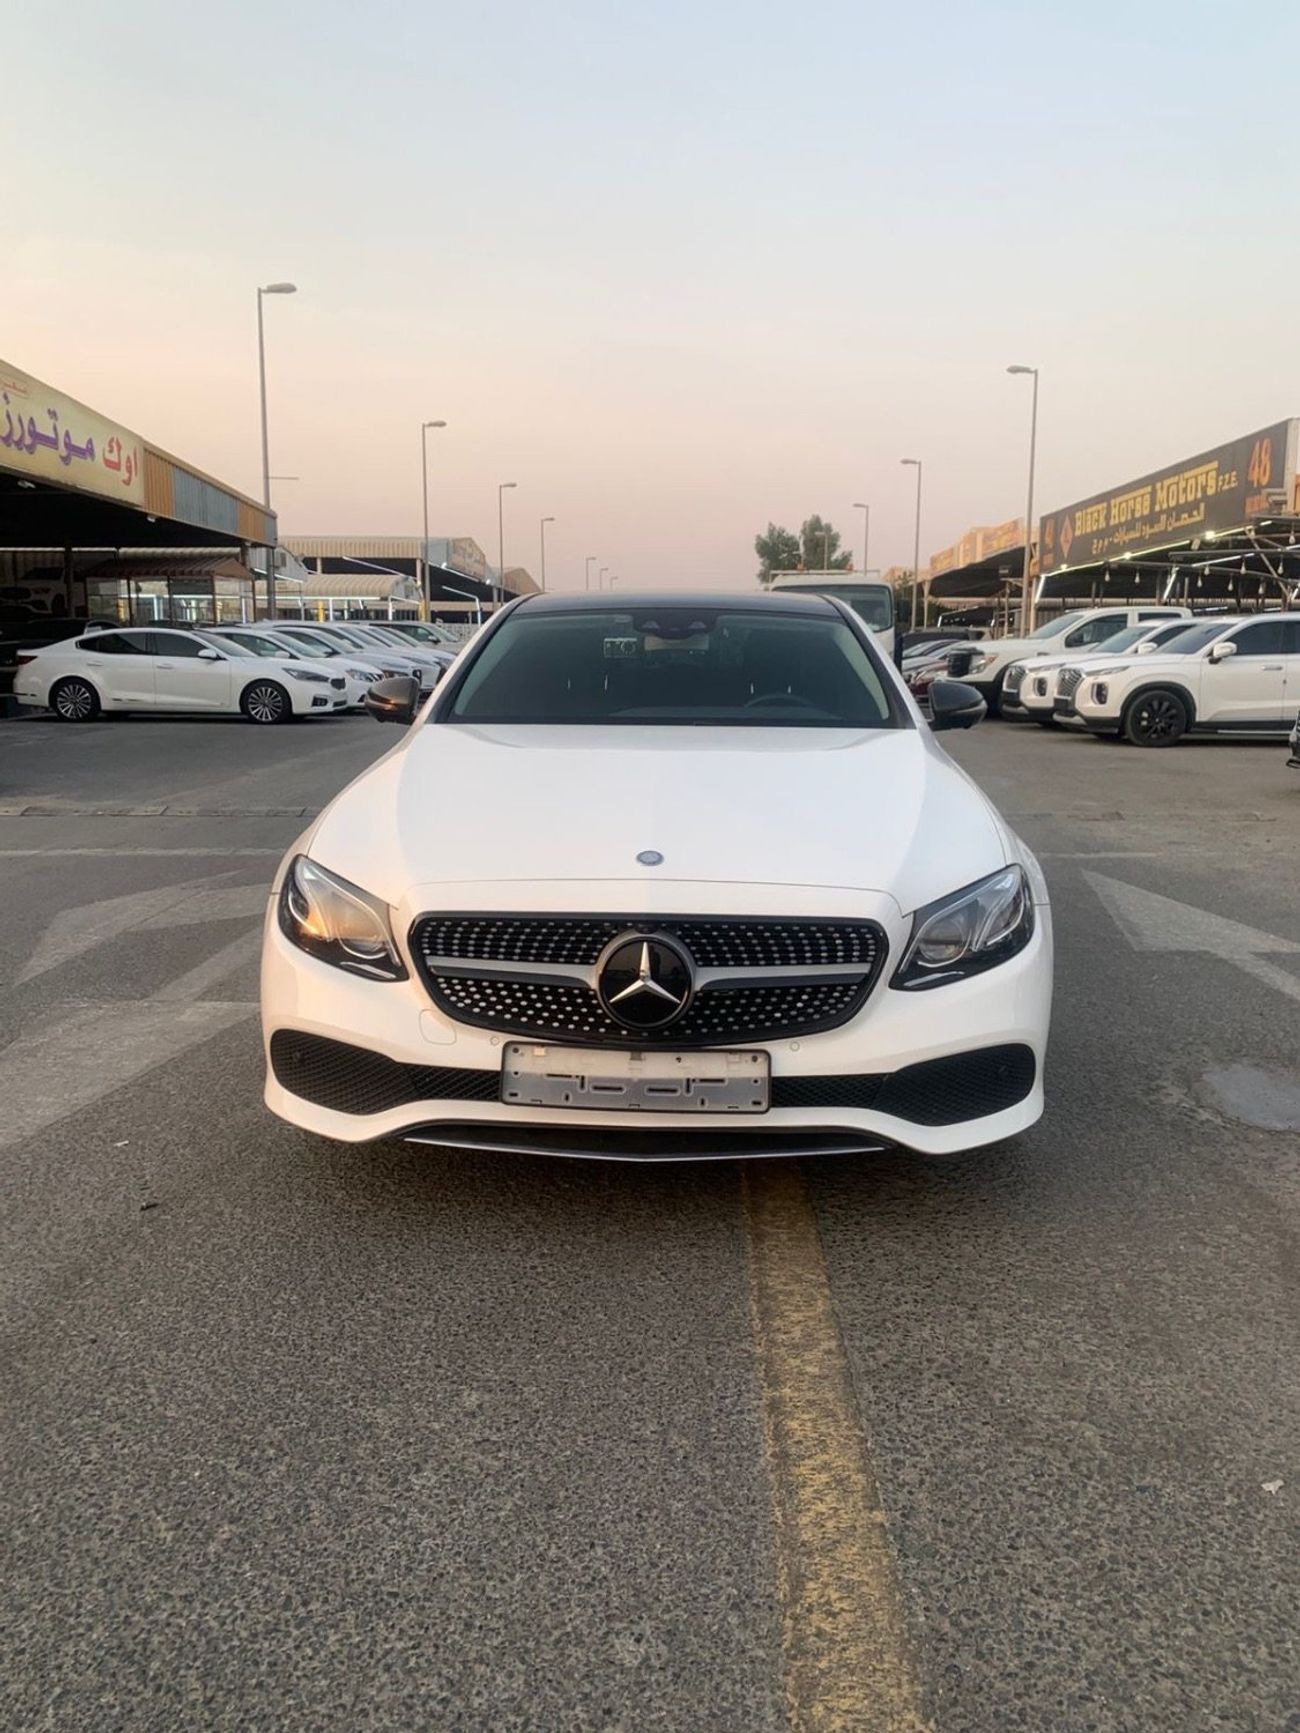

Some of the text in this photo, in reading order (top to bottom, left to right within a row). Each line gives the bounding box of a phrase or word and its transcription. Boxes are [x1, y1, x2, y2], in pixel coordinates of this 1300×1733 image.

[0, 392, 96, 465] موتورز
[1248, 437, 1272, 488] 48
[1074, 502, 1107, 537] Black
[1109, 485, 1152, 527] Horse
[1154, 460, 1219, 512] Motors
